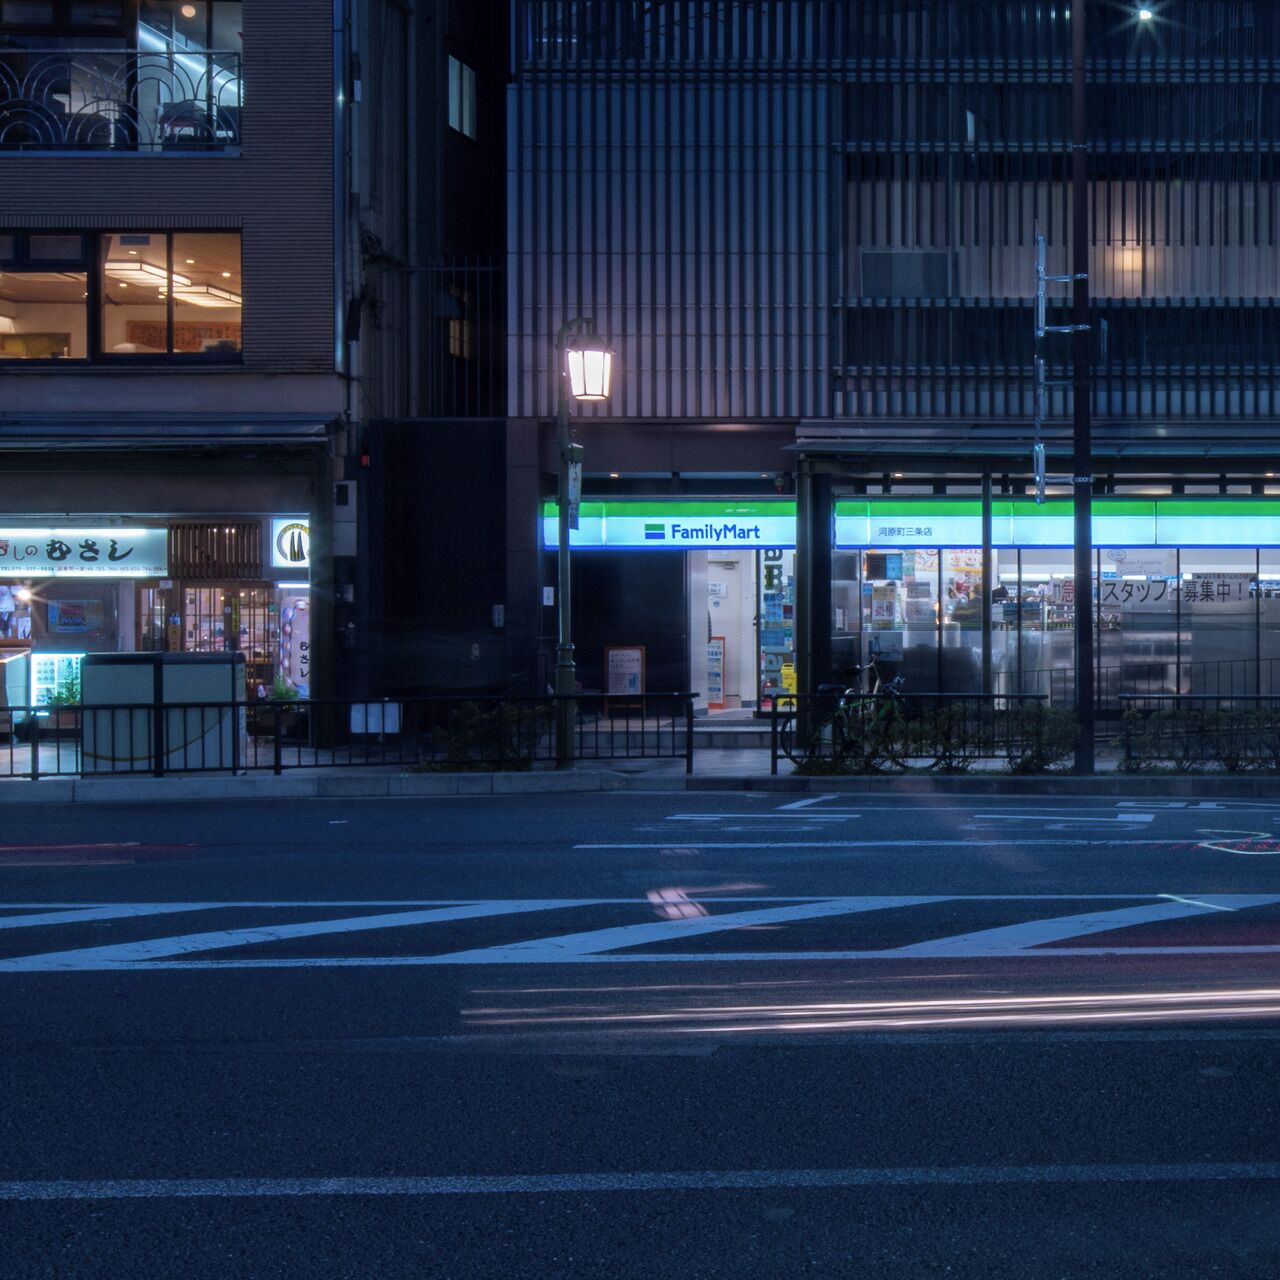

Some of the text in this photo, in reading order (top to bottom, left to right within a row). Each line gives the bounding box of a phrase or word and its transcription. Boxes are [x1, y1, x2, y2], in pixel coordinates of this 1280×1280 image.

[671, 523, 761, 541] FamilyMart
[878, 526, 933, 538] 河原町三条店
[46, 538, 134, 562] むさし
